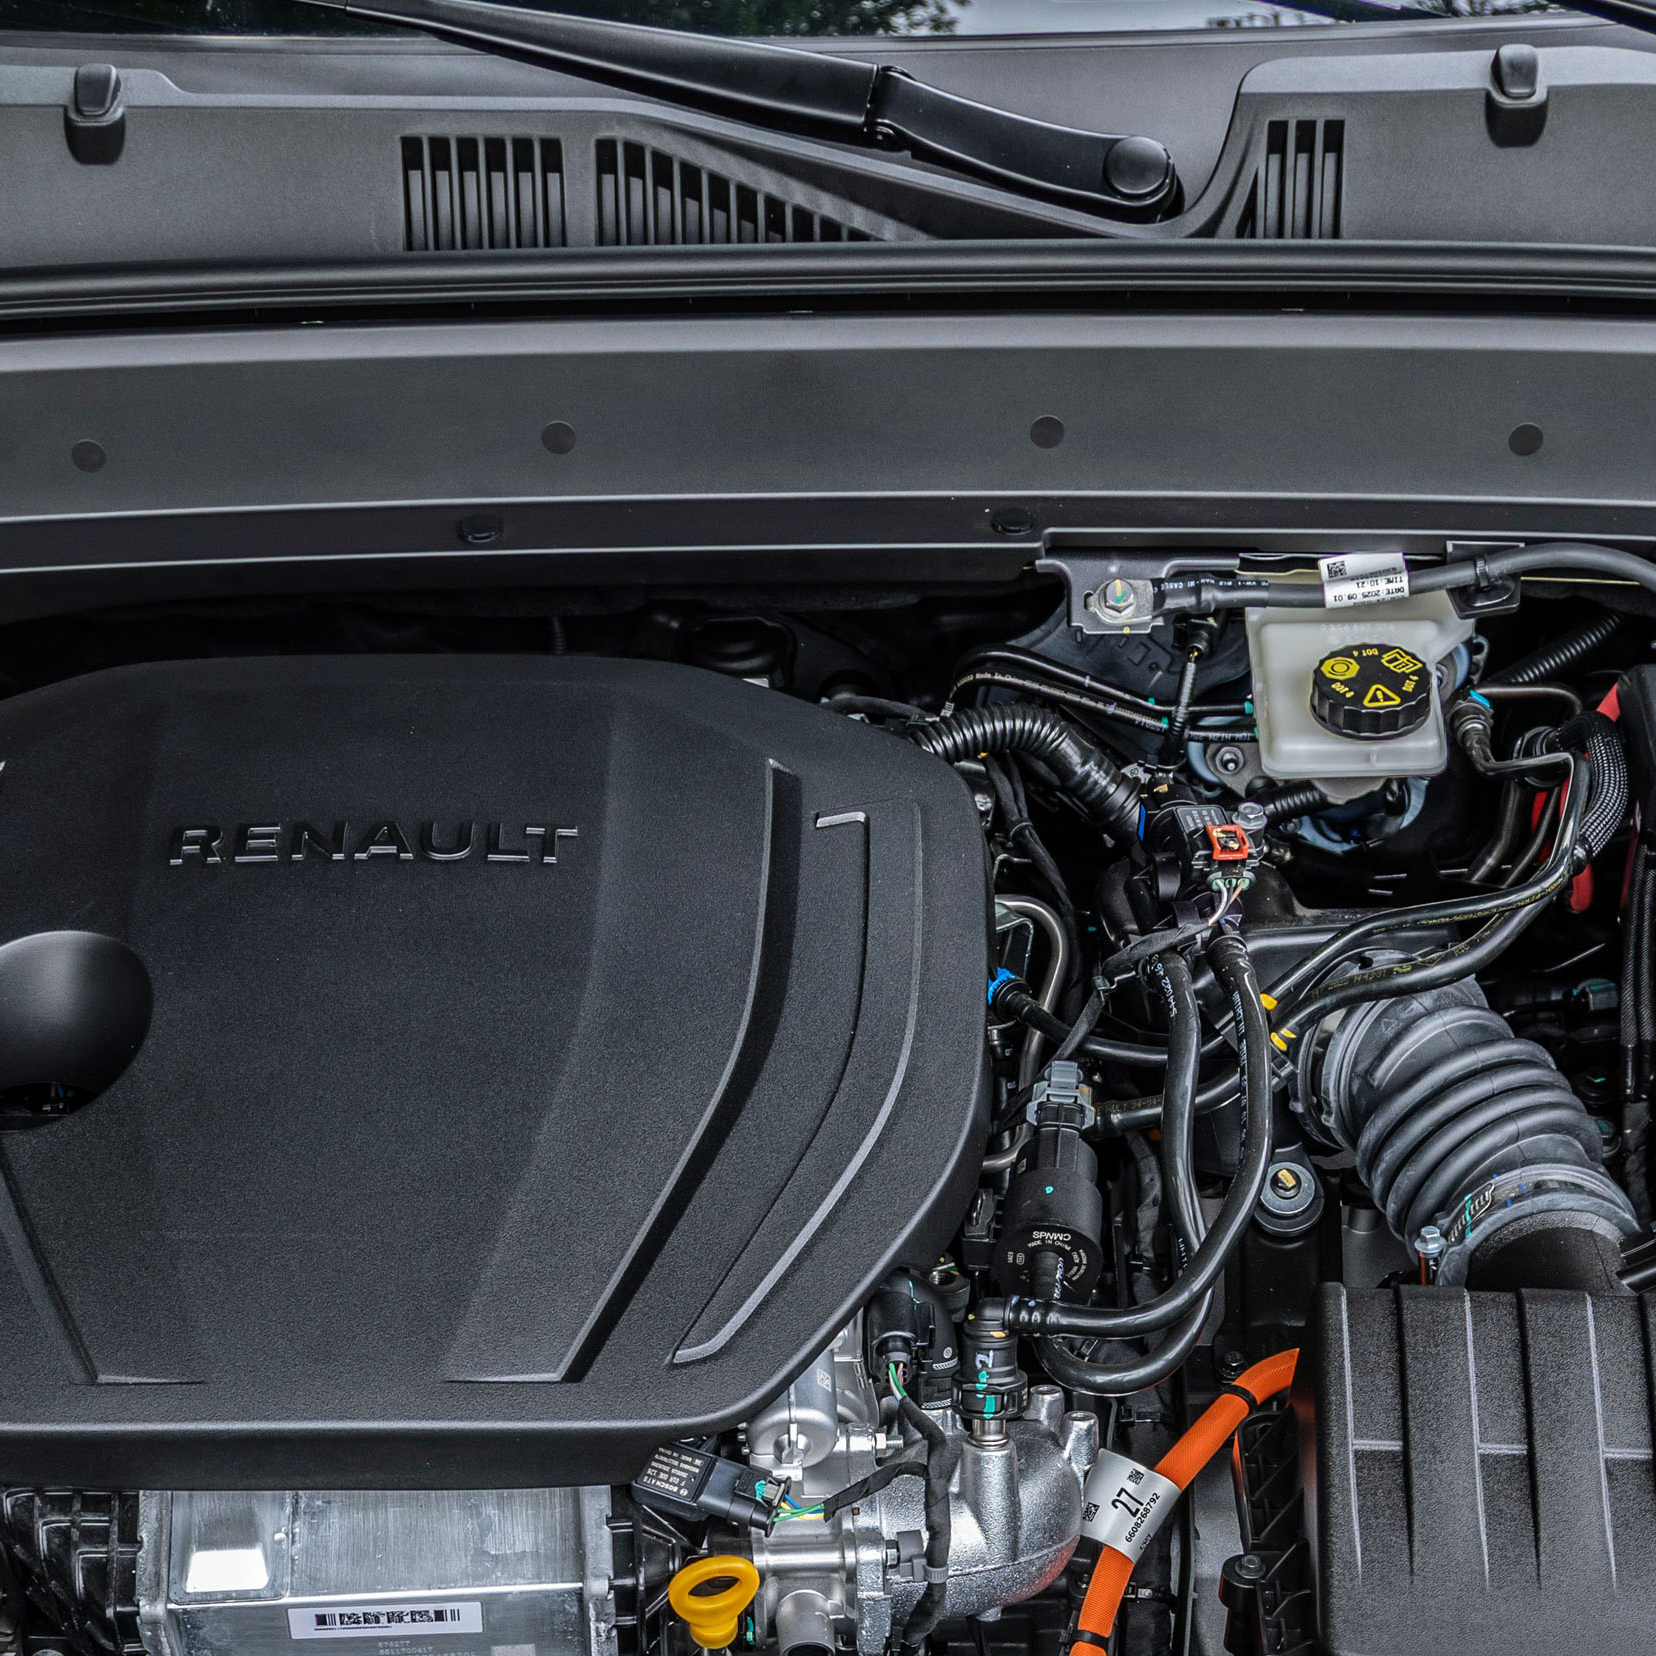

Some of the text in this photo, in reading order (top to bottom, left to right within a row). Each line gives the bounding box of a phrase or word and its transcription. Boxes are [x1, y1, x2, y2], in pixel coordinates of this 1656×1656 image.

[168, 820, 579, 867] RENAULT
[1112, 1487, 1146, 1519] 27
[1123, 1492, 1162, 1543] 6608268792
